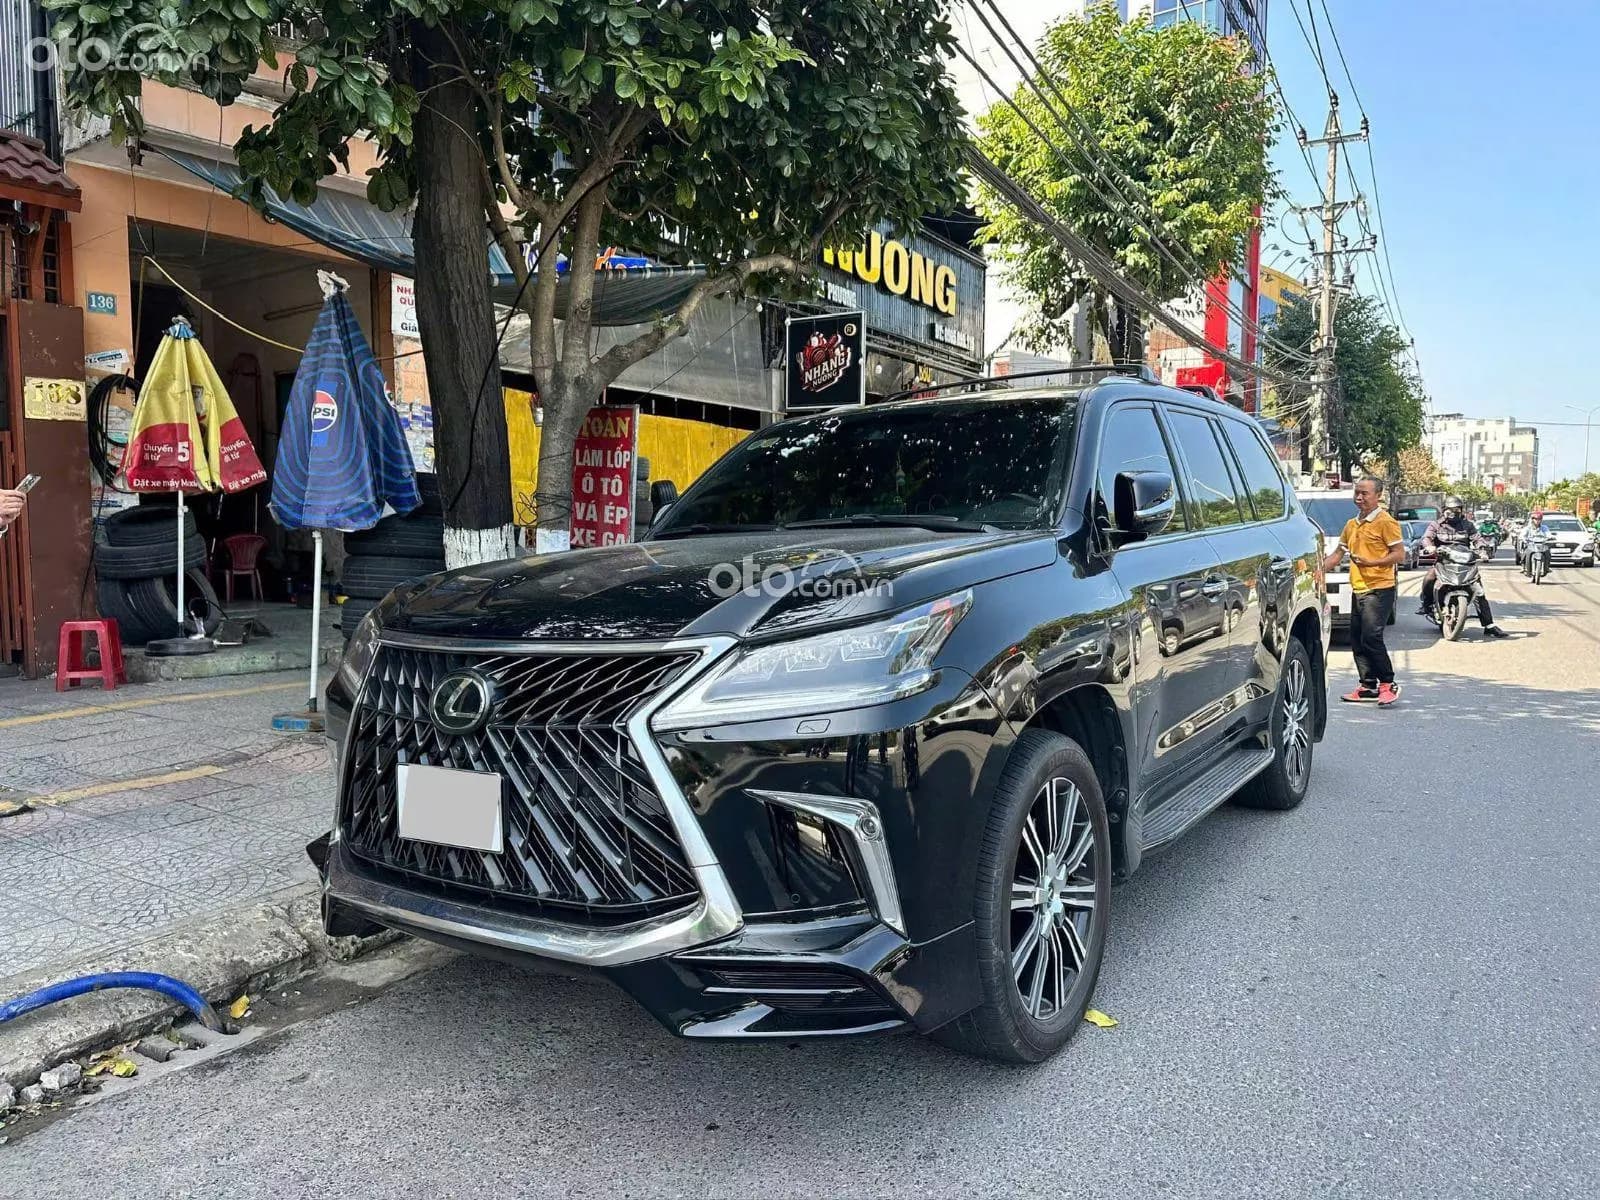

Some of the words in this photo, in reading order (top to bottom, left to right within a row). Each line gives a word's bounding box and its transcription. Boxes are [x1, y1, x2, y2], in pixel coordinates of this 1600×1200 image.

[90, 294, 114, 310] 136
[31, 382, 82, 405] 138
[143, 442, 173, 453] Chuyến
[177, 441, 190, 462] 5
[576, 444, 602, 467] LÀM
[607, 444, 630, 469] LỐP
[133, 478, 150, 488] Đặt
[163, 479, 179, 488] máy
[240, 476, 251, 485] xe
[582, 472, 594, 494] Ô
[600, 474, 623, 496] TÔ
[575, 499, 598, 521] VÁ
[603, 501, 628, 525] ÉP
[571, 528, 596, 547] XE
